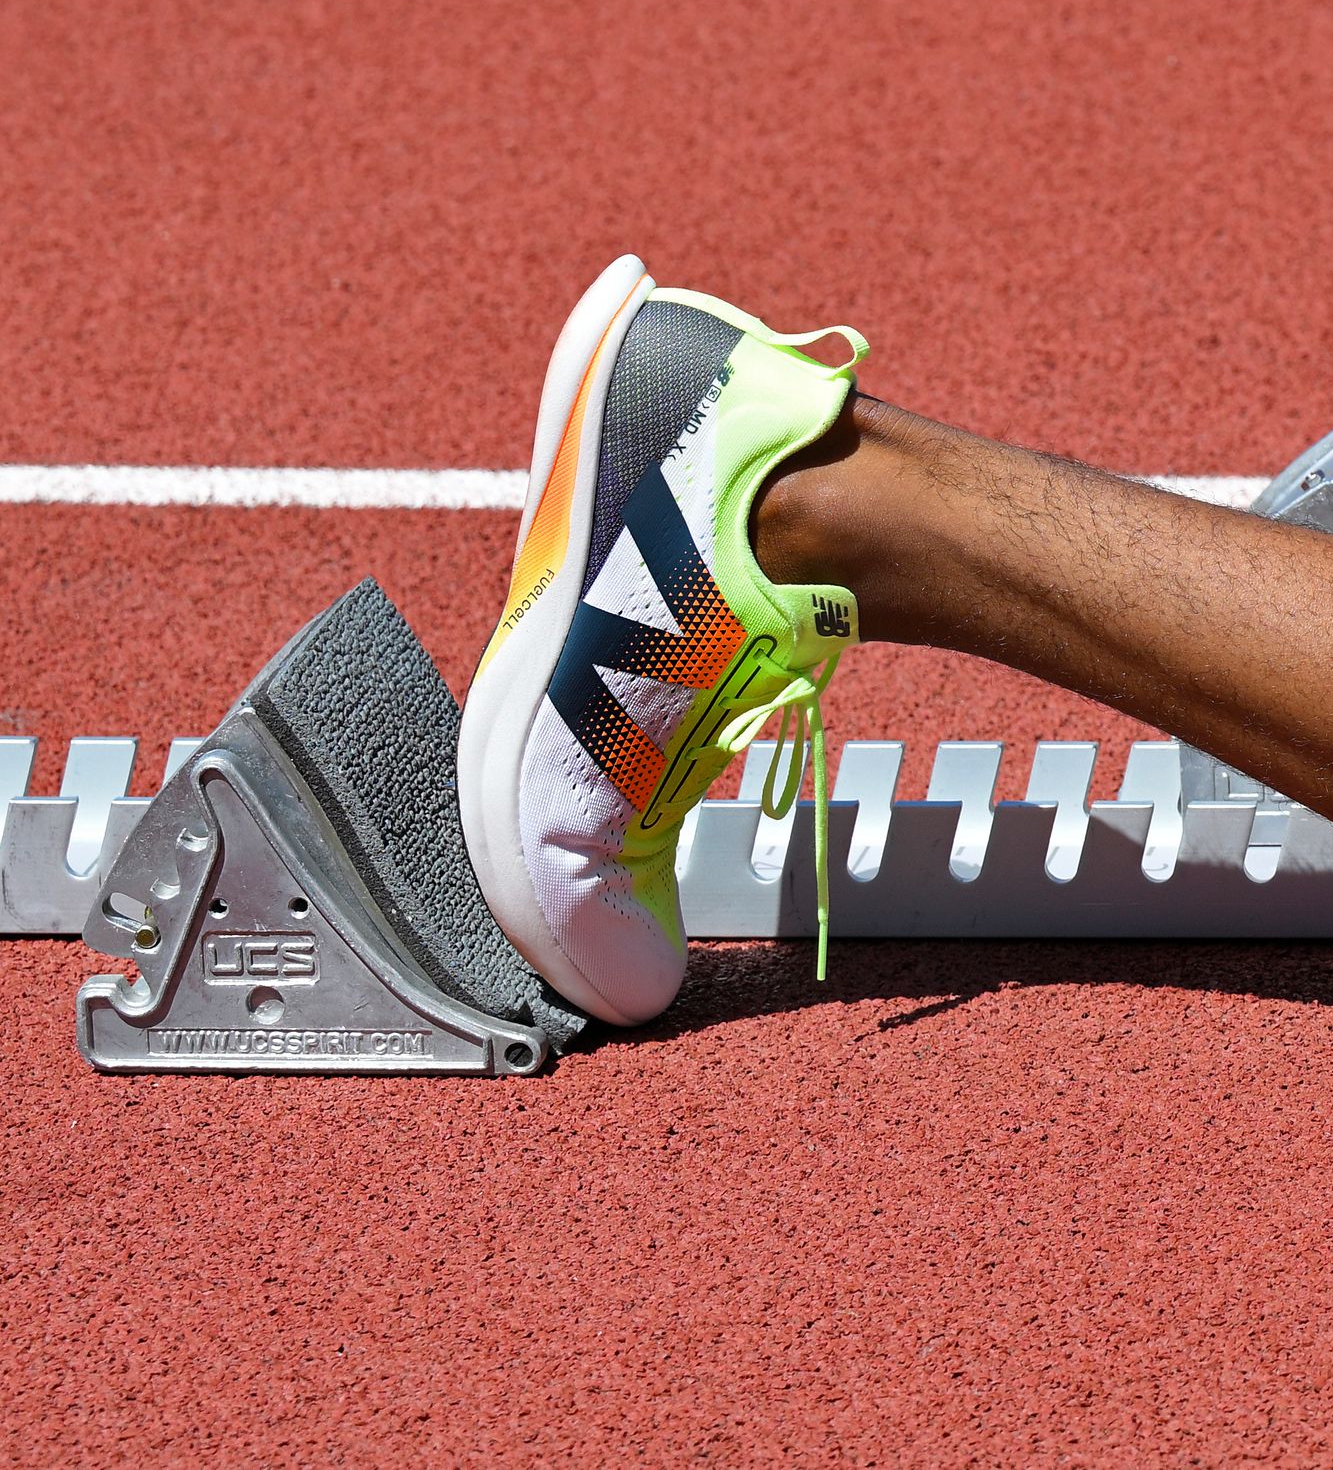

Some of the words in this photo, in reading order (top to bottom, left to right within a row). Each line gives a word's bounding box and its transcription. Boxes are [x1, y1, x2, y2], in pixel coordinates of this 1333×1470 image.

[684, 409, 707, 435] MD
[811, 593, 851, 638] NB
[207, 942, 315, 977] UCS
[157, 1030, 425, 1056] WWW.UCSSPIRITCOM
